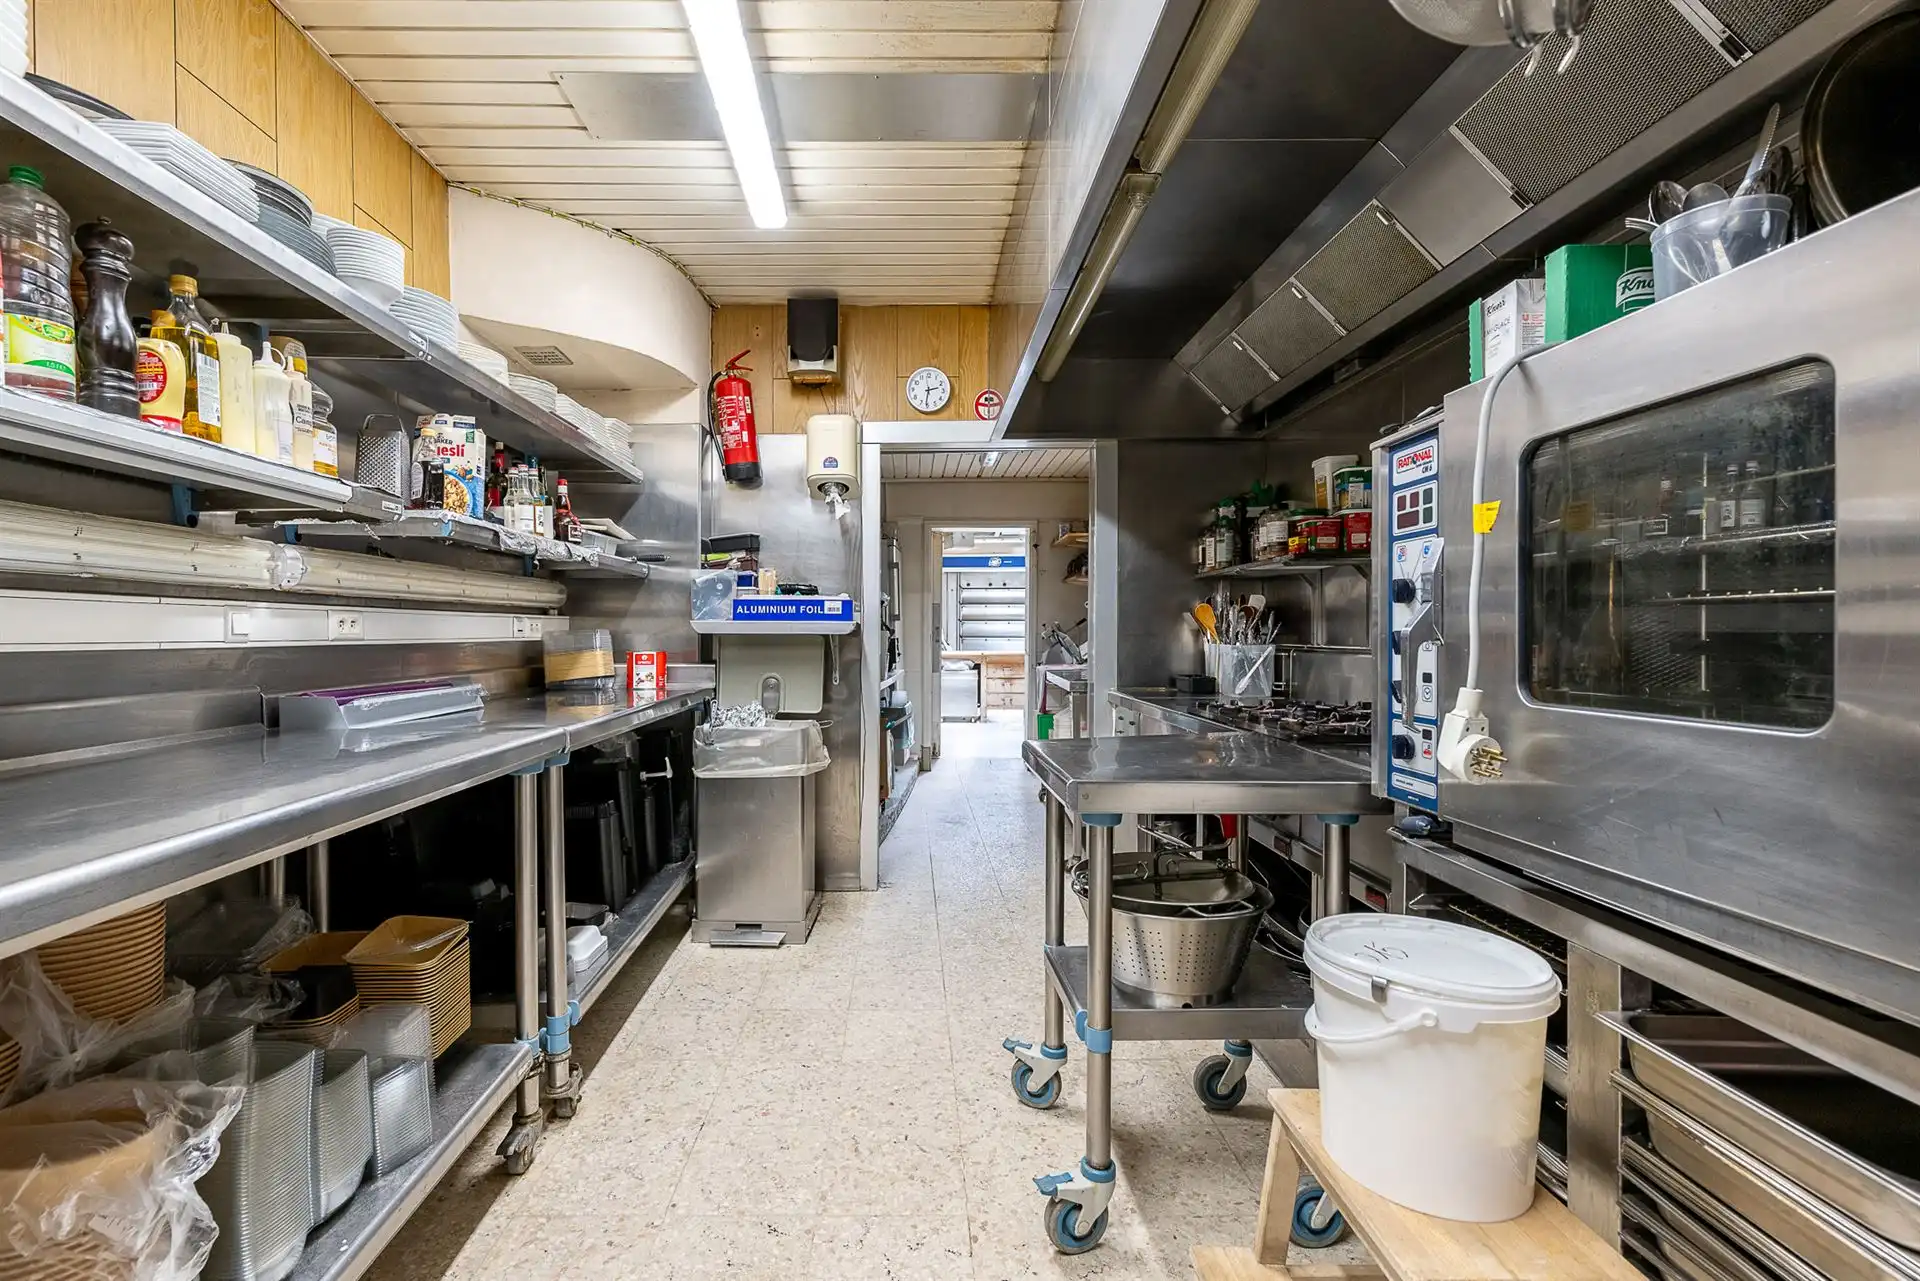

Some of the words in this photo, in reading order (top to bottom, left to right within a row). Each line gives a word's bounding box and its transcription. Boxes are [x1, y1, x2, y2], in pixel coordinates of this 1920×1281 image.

[1397, 449, 1433, 469] RATIONAL
[736, 605, 796, 614] ALUMINIUM
[800, 605, 823, 614] FOIL
